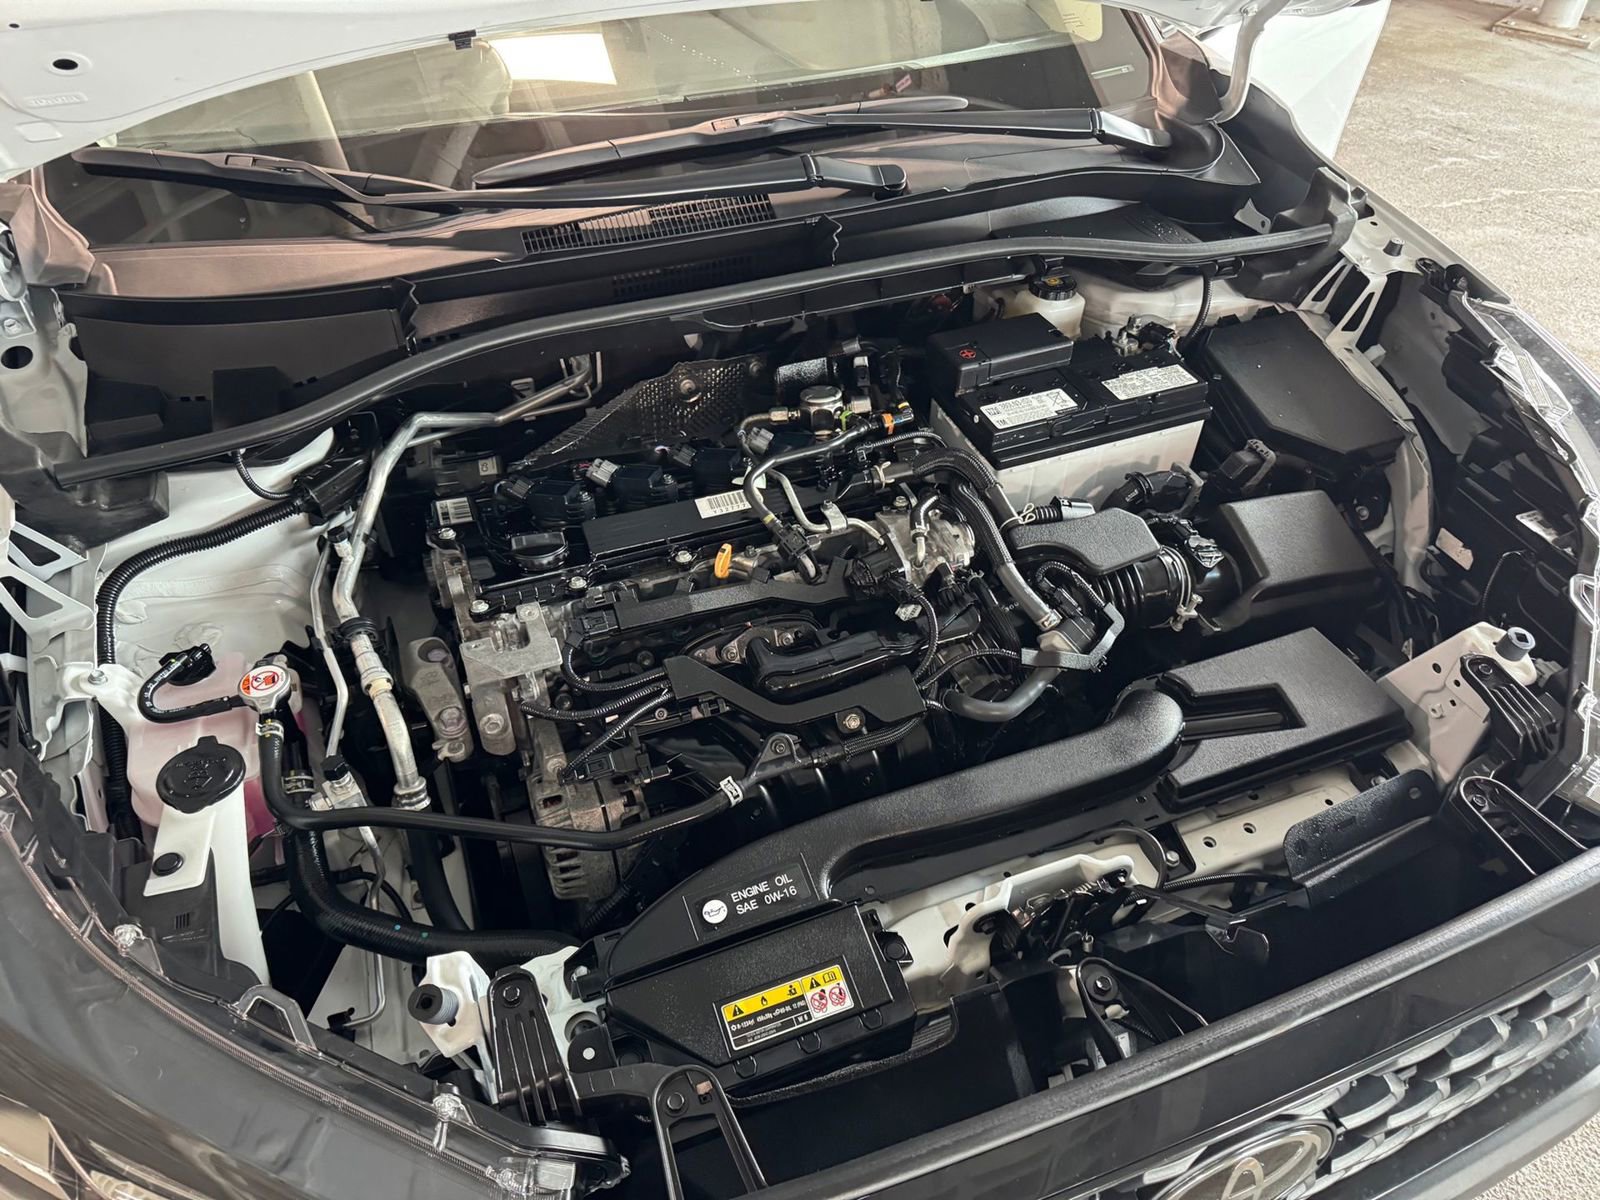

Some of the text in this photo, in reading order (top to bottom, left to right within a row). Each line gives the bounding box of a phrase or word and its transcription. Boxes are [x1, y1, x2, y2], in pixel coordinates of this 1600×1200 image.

[730, 873, 793, 902] ENGINE OIL
[735, 885, 797, 915] SAE 0W-16
